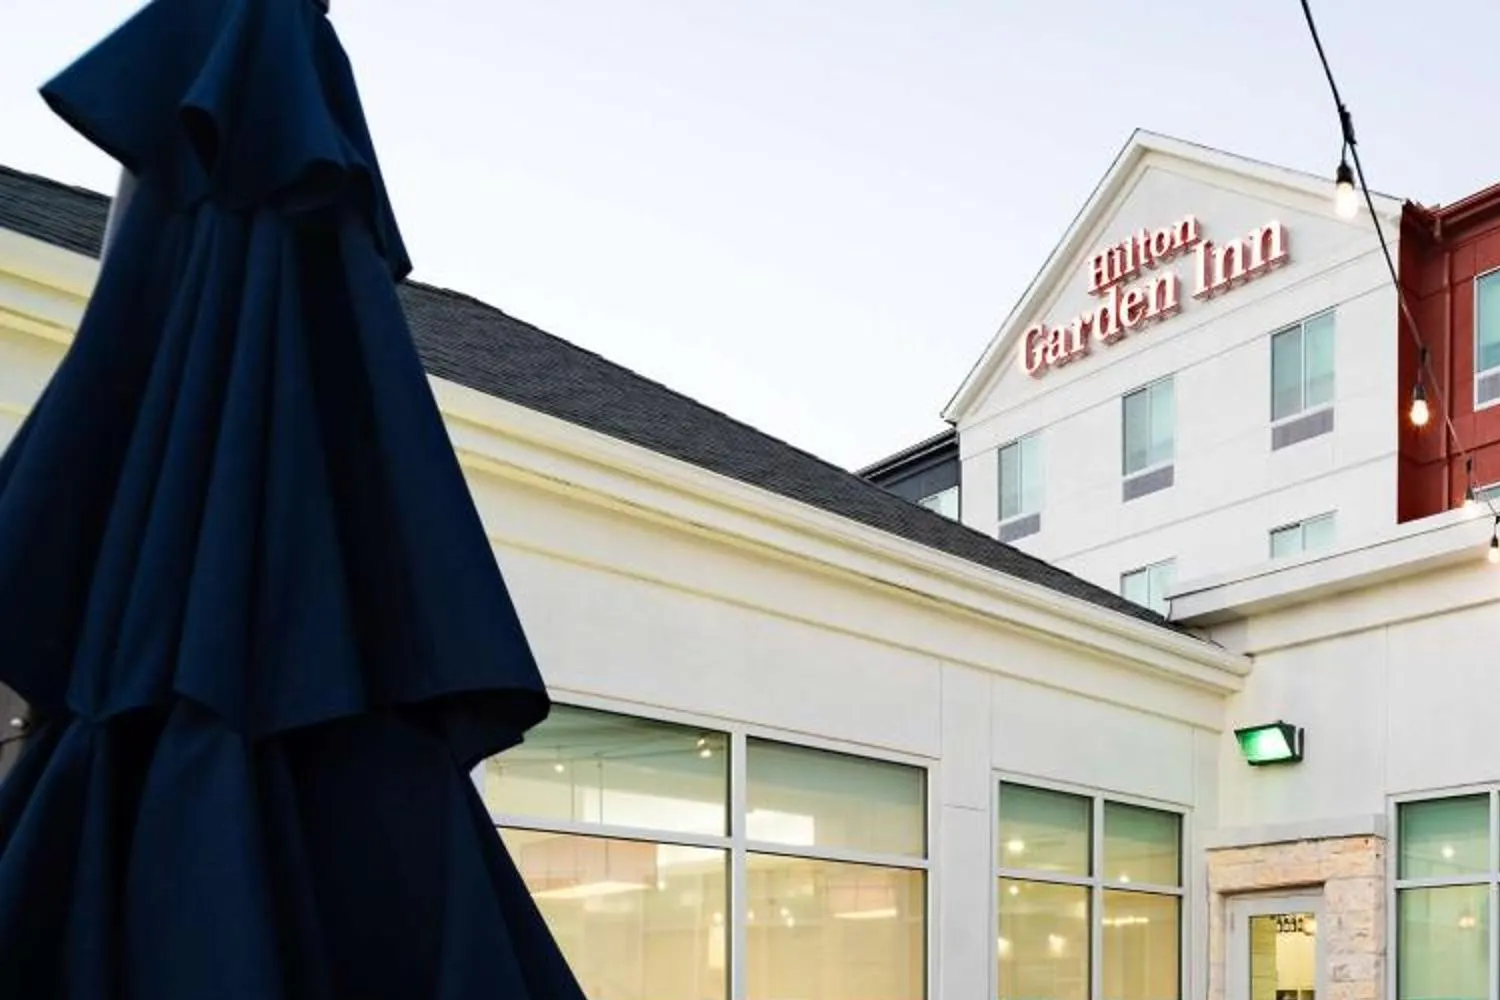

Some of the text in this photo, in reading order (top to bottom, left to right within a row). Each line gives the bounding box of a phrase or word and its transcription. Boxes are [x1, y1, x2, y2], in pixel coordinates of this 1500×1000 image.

[1020, 219, 1291, 378] Garden Inn
[1088, 214, 1202, 294] Hilton
